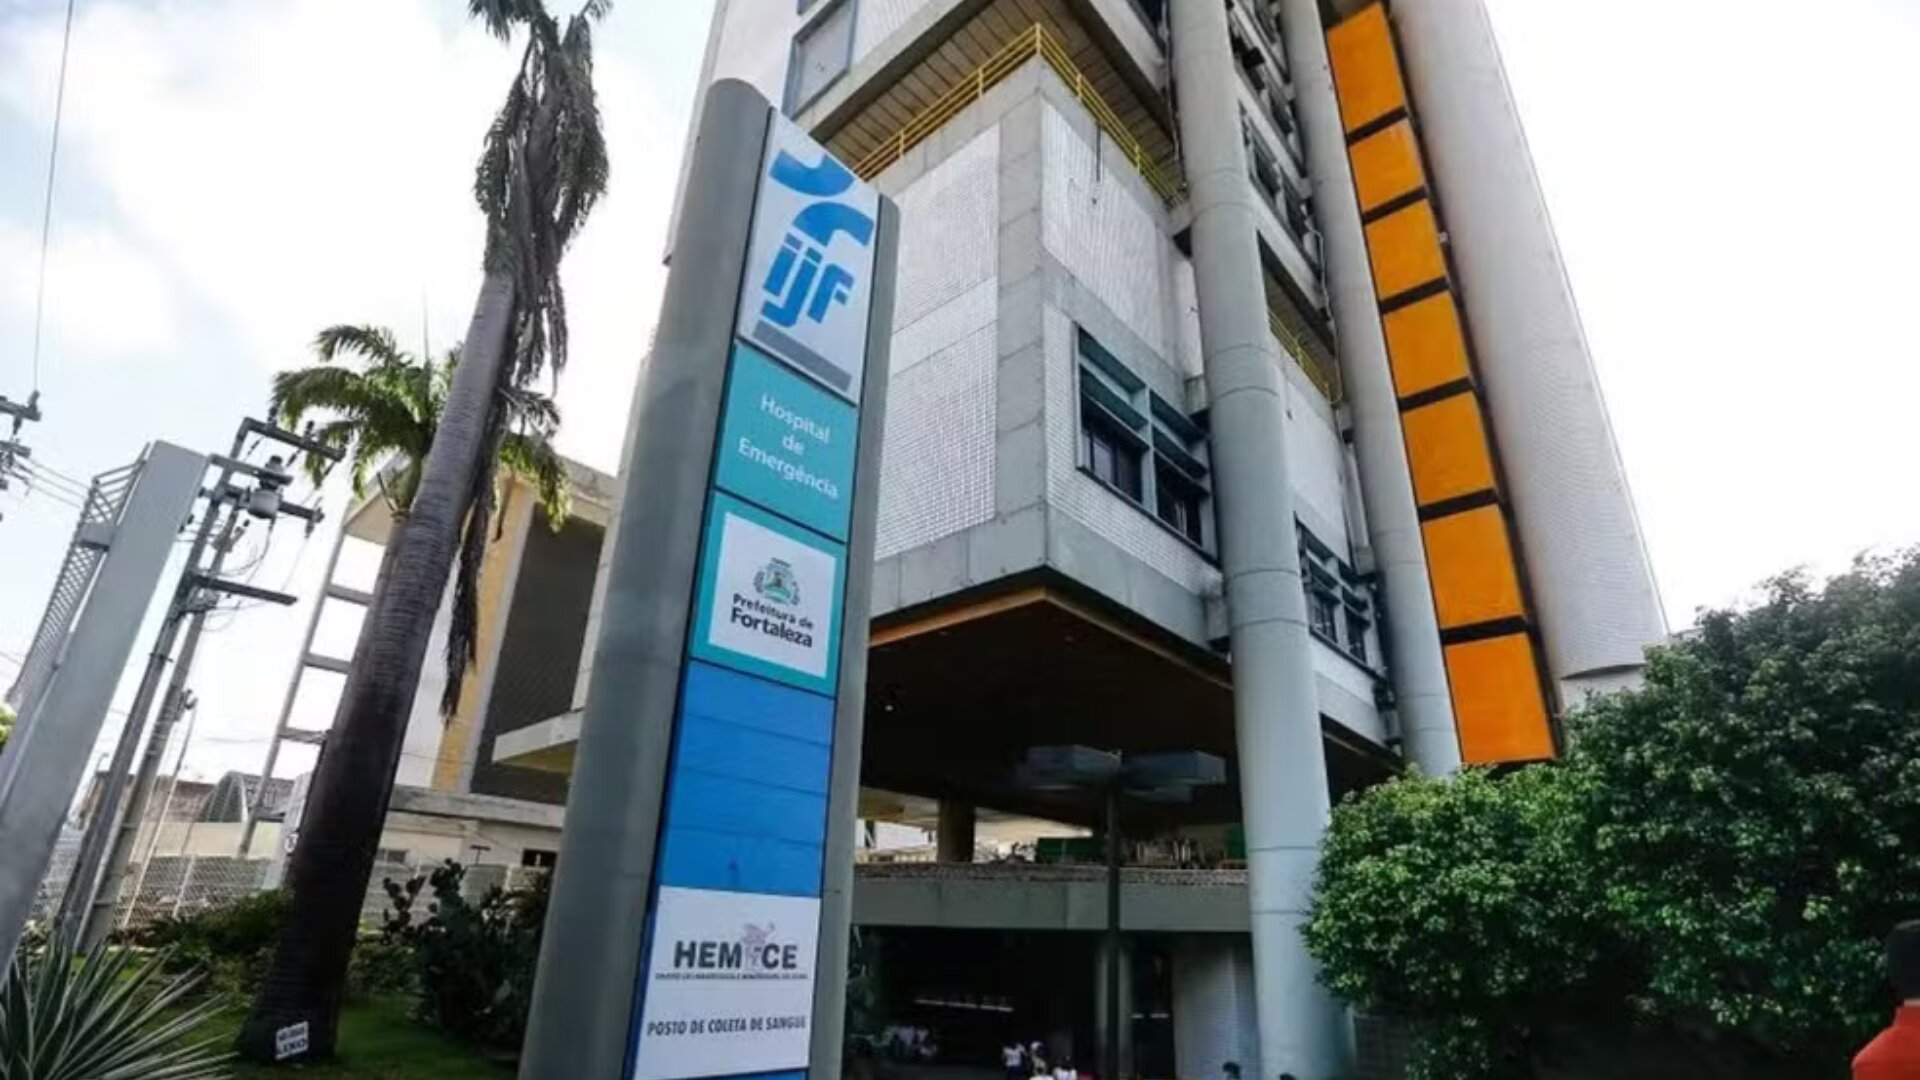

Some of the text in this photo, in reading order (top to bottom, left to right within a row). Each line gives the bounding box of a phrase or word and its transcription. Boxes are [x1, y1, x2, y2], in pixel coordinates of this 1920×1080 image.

[762, 232, 855, 328] ijf
[760, 393, 830, 444] Hospital
[782, 434, 805, 456] de
[738, 437, 838, 499] Emergência
[730, 607, 813, 648] Fortaleza
[733, 593, 814, 630] Prefeitura de
[674, 940, 798, 970] HEMCE
[647, 1015, 807, 1037] POSTO DE COLETA DE SANGUE
